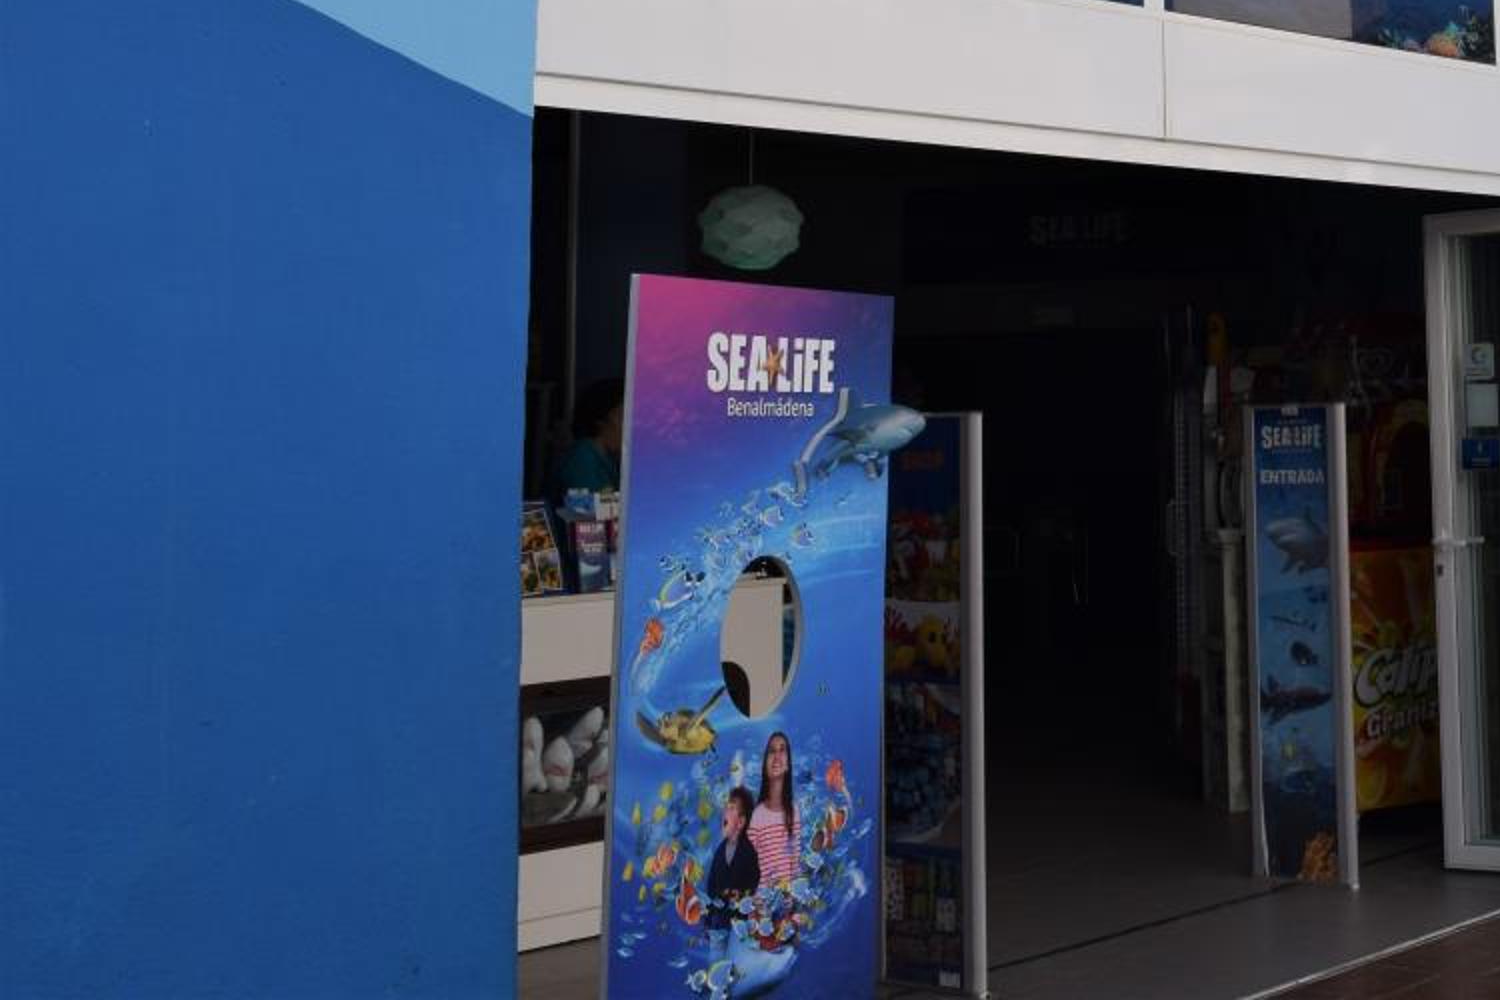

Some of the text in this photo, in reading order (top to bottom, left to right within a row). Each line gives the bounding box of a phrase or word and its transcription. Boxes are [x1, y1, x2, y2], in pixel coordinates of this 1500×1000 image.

[706, 331, 769, 393] SEA
[726, 396, 815, 418] Benalmádena
[1259, 468, 1325, 486] ENTRADA
